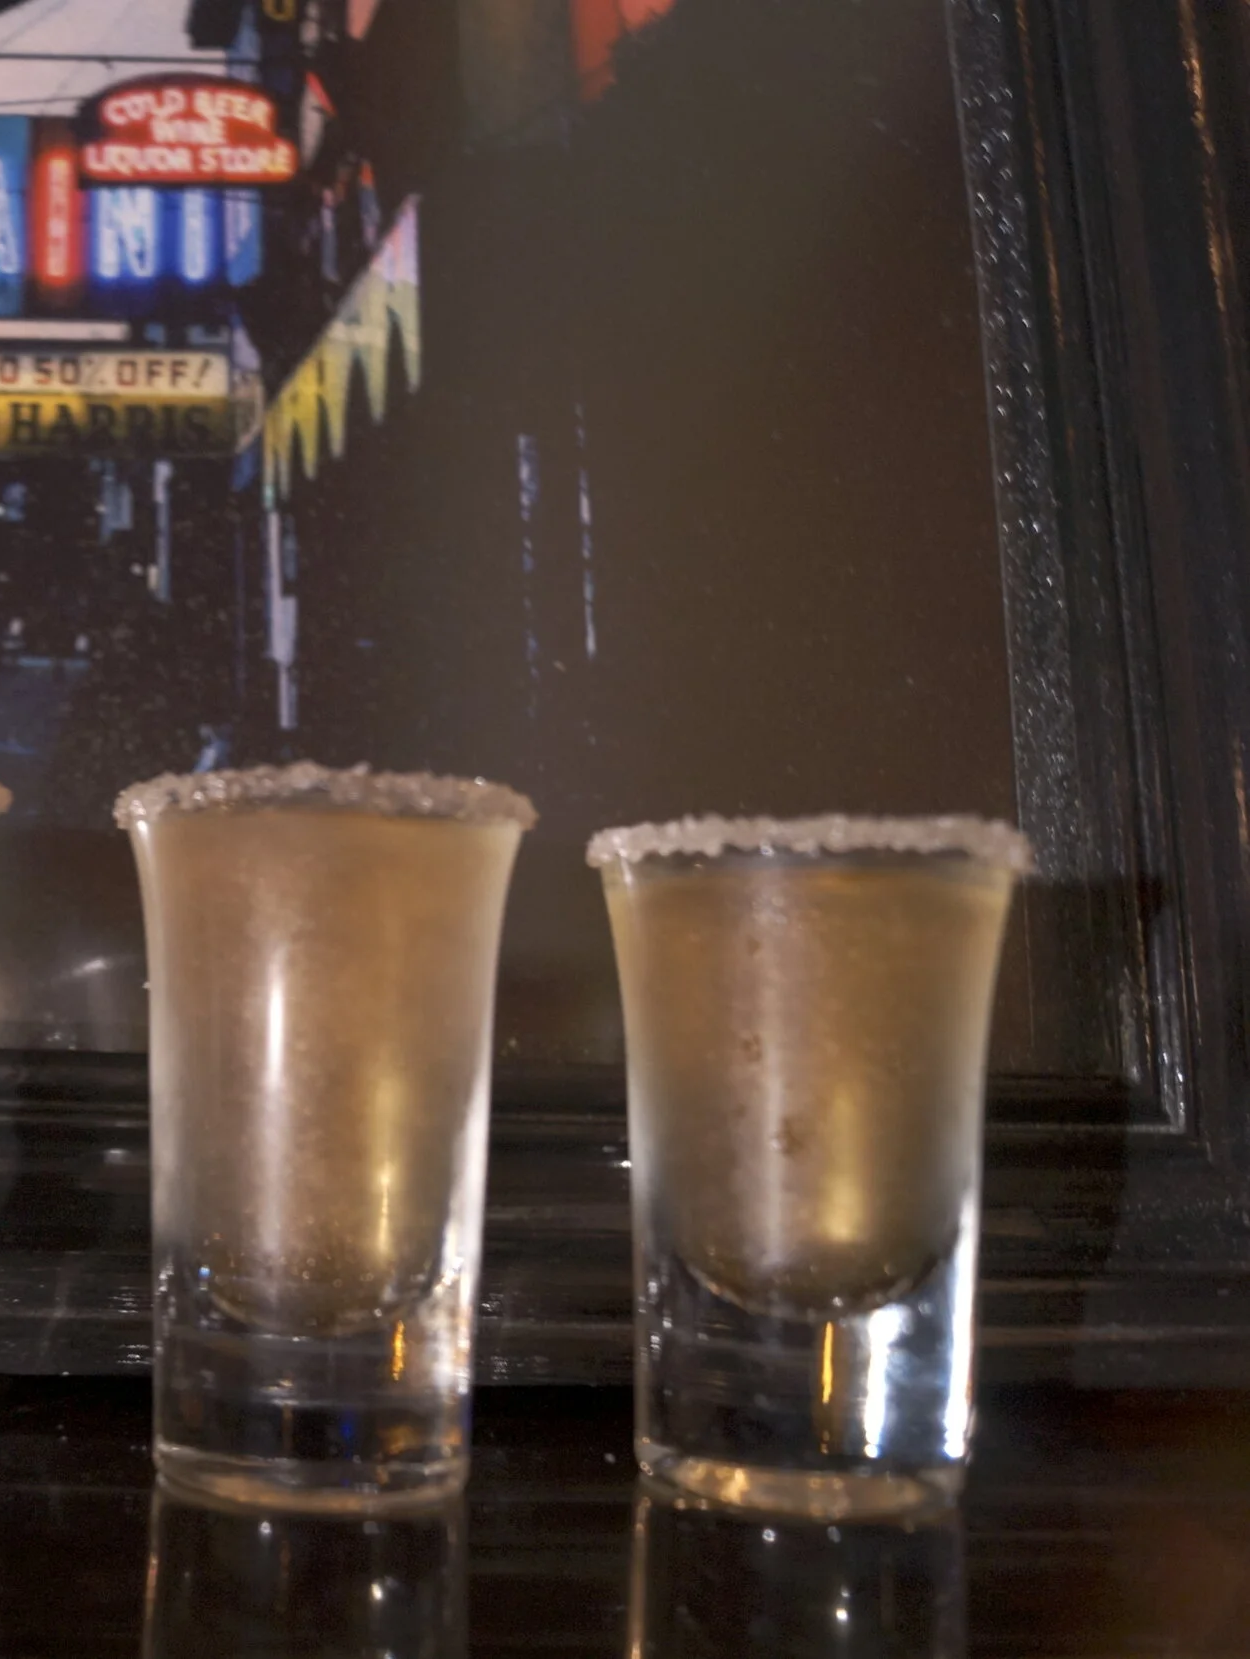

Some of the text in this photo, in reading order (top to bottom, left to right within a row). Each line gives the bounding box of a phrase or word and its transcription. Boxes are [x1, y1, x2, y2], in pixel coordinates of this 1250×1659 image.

[102, 87, 271, 130] COLD BEER
[85, 140, 294, 176] LIQUOR STORE
[116, 357, 213, 388] OFF!
[7, 400, 211, 450] HARRIS
